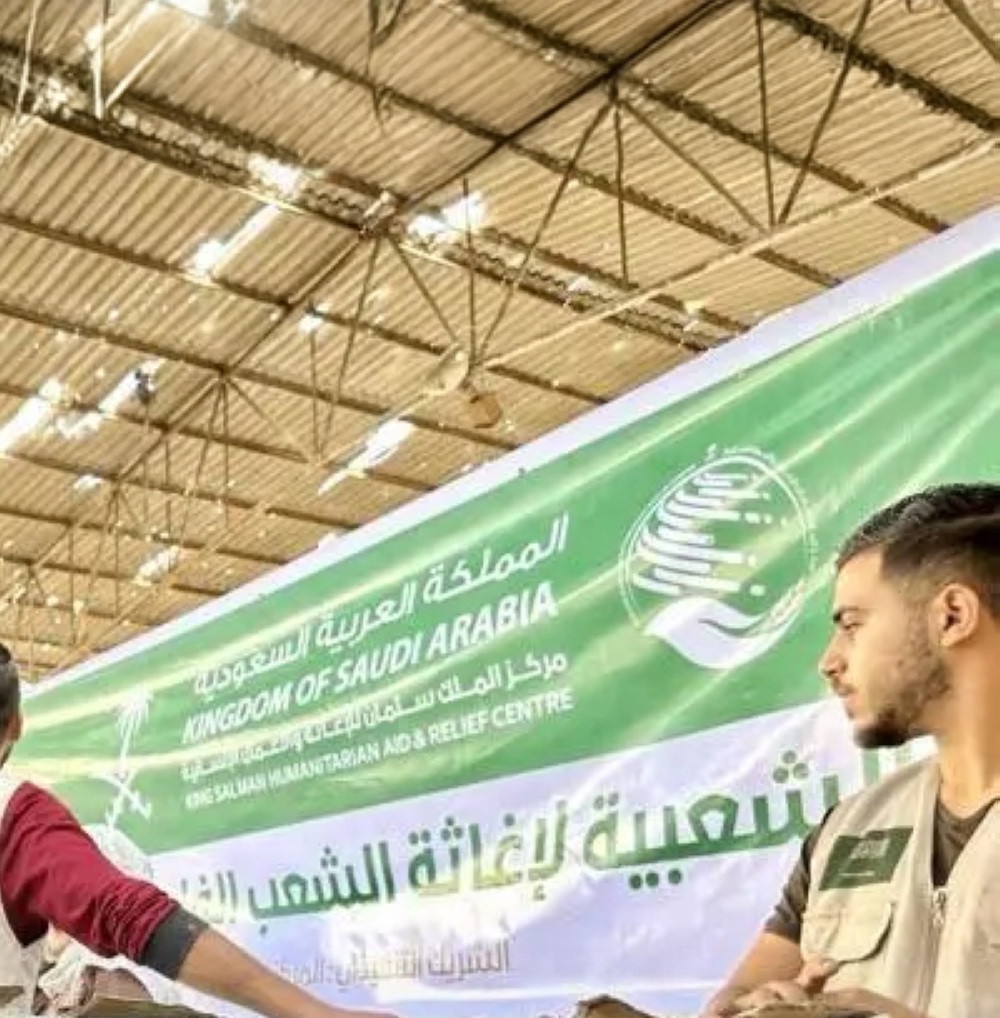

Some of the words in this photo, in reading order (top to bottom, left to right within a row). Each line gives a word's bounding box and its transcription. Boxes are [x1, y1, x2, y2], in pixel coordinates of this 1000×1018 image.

[425, 514, 568, 602] المملكة
[183, 680, 293, 744] KINGDOM
[295, 666, 334, 706] OF
[334, 631, 423, 693] SAUDI
[427, 580, 560, 660] ARABIA
[318, 583, 417, 653] العربية
[438, 663, 502, 704] الملك
[500, 652, 568, 691] مركز
[215, 771, 267, 803] SALMAN
[268, 742, 380, 790] HUMANITARIAN
[383, 731, 411, 757] AID
[413, 728, 427, 750] &
[428, 709, 490, 745] RELIEF
[492, 688, 574, 727] CENTRE
[583, 748, 880, 892] شعبية
[248, 840, 396, 938] الشعب
